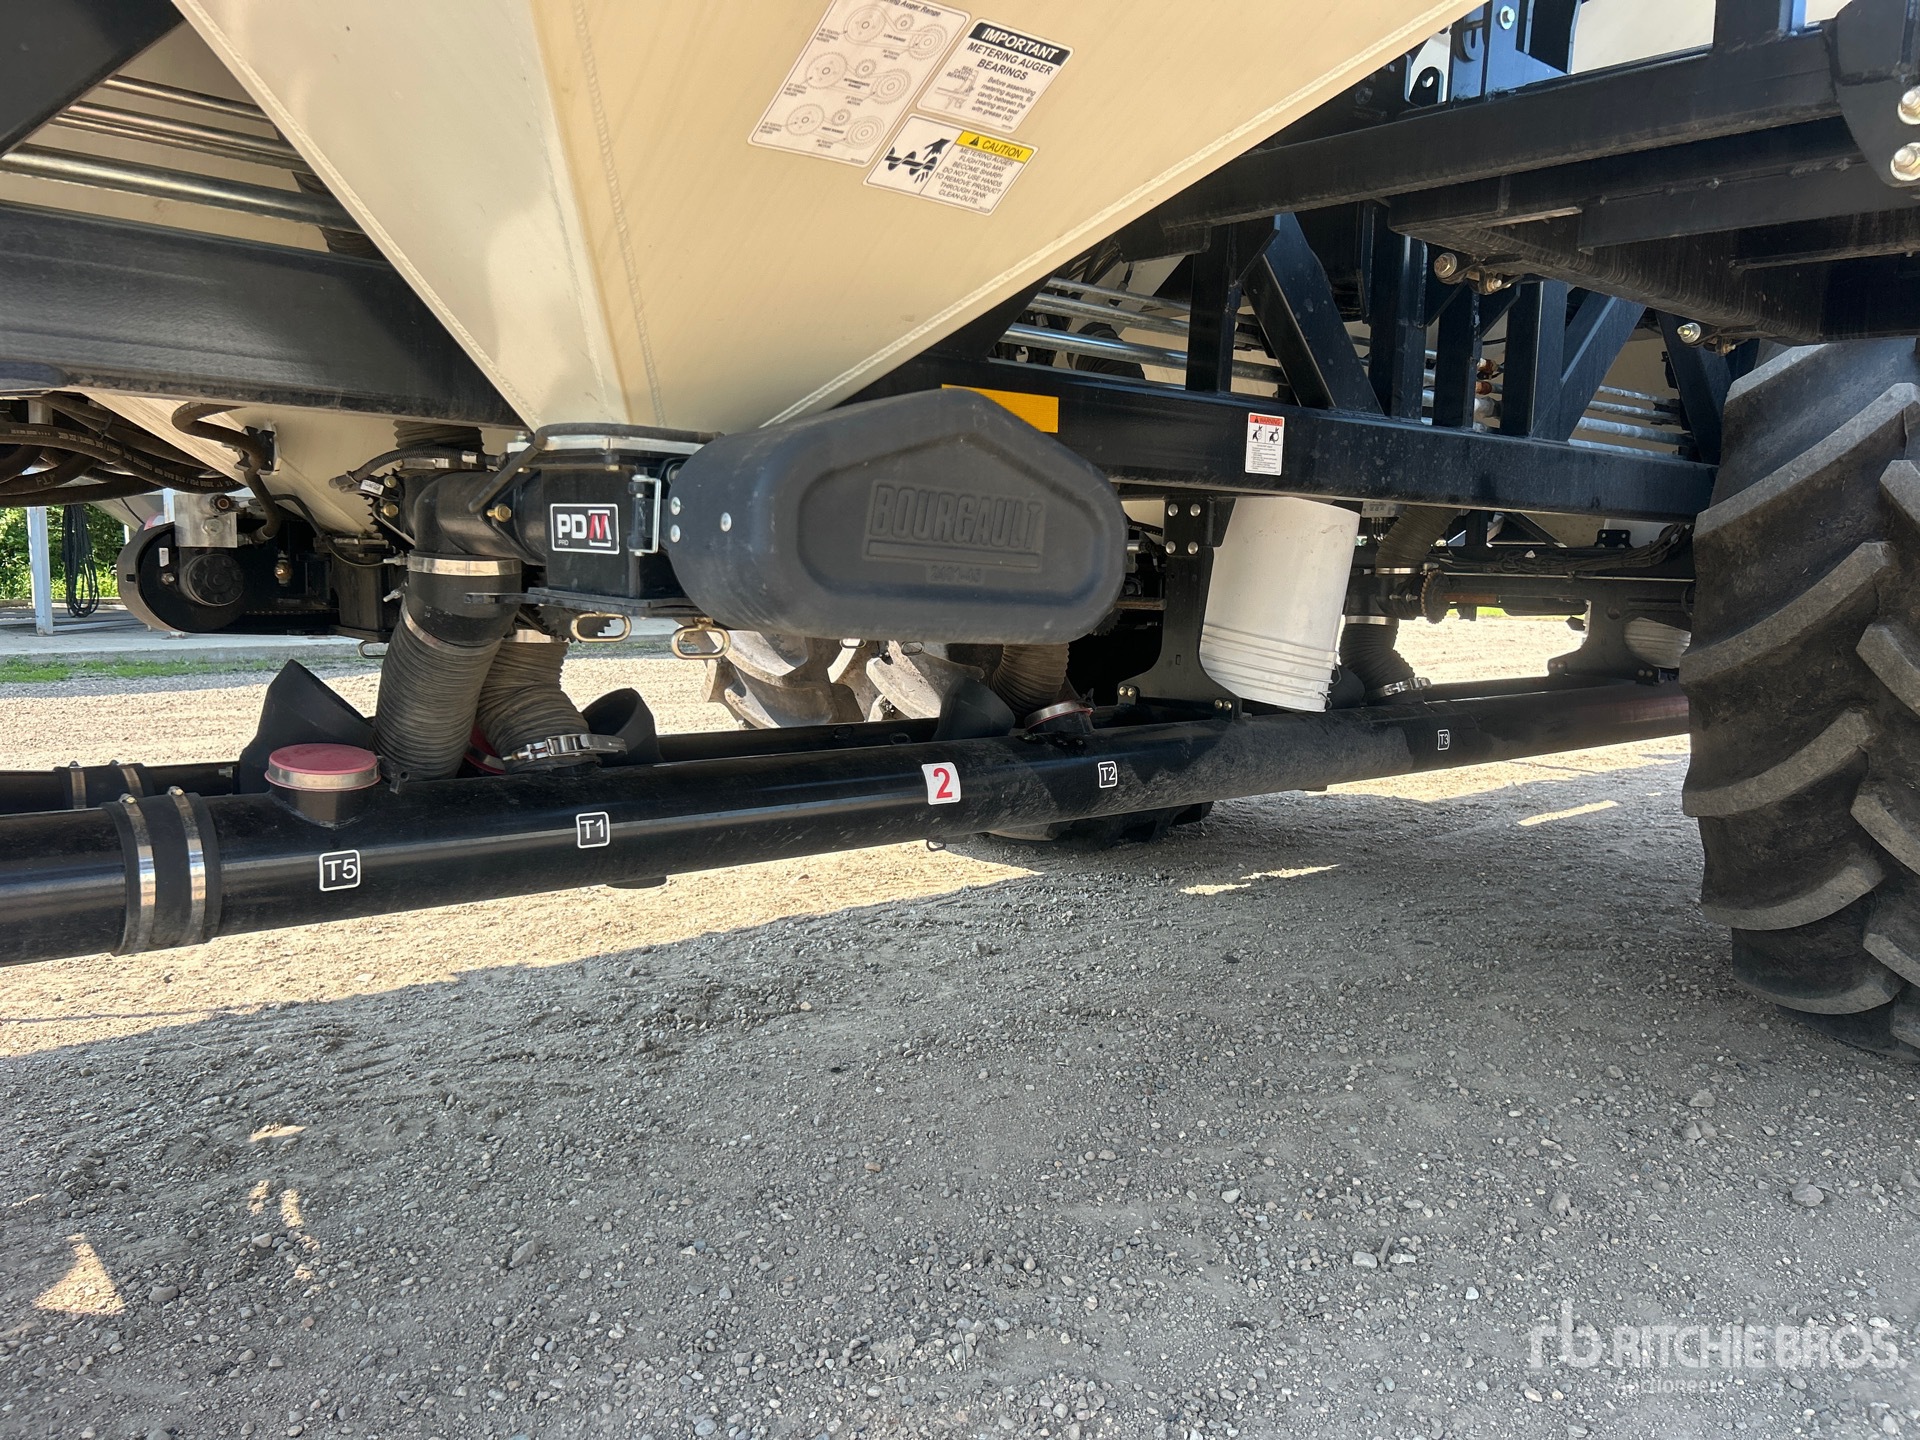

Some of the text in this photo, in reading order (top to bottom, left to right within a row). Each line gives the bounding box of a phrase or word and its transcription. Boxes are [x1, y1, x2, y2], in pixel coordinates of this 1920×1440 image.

[920, 5, 941, 17] Range
[981, 27, 1060, 60] IMPORTANT
[967, 42, 1053, 75] METERING AUGER
[977, 58, 1028, 81] BEARINGS
[981, 84, 1006, 96] metering
[987, 76, 1036, 97] Before assembling
[975, 98, 1019, 115] bearing and seal
[977, 91, 994, 101] cavity
[994, 95, 1017, 107] between
[982, 108, 1002, 118] grease
[959, 147, 1015, 168] METERING AUGER
[982, 140, 1024, 159] CAUTION
[952, 161, 980, 174] BECOME
[958, 155, 1007, 172] FLIGHTING MAY
[935, 172, 1002, 195] TO REMOVE PRODUCT
[942, 166, 1003, 188] DO NOT USE HANDS
[940, 181, 988, 200] THROUGH TANK
[556, 513, 612, 541] PDM
[869, 484, 1043, 550] BOURGAULT
[1439, 733, 1449, 746] T3
[933, 768, 953, 799] 2
[1100, 766, 1116, 782] T2
[580, 819, 605, 839] T1
[324, 858, 357, 881] T5
